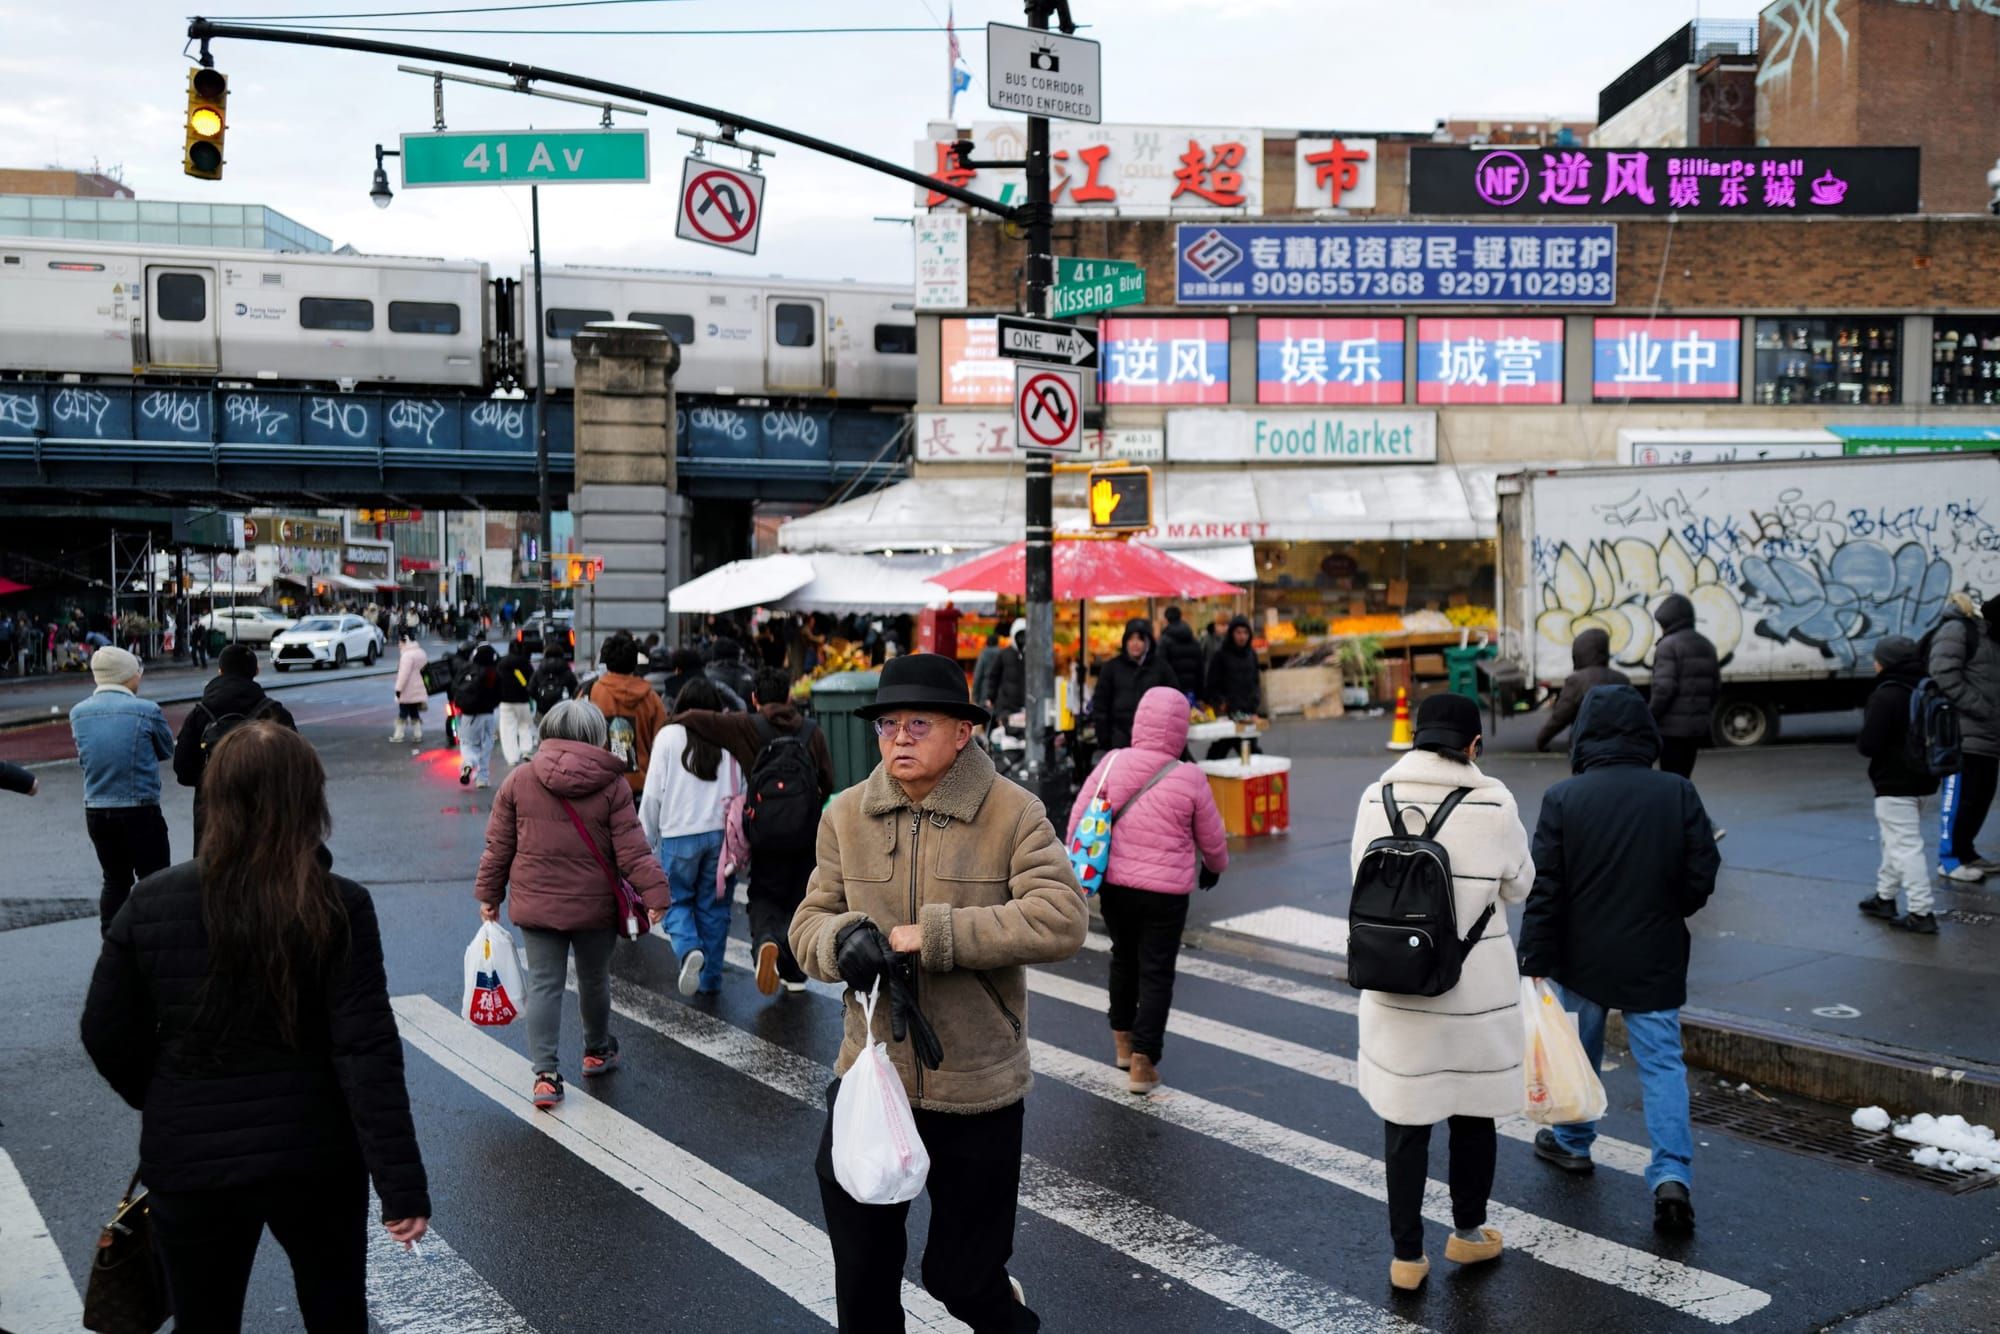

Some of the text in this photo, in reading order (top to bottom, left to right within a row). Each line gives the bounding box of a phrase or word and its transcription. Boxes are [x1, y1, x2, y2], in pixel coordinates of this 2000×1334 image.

[1005, 72, 1085, 96] BUS CORRIDOR
[998, 90, 1092, 116] PHOTO ENFORCED
[463, 142, 507, 173] 41
[1761, 159, 1803, 177] Hall
[1484, 166, 1520, 196] NF
[1538, 151, 1656, 206] 逆风
[1669, 176, 1797, 208] 娱乐城
[1073, 263, 1095, 282] 41
[1252, 271, 1425, 296] 9096557368
[1438, 271, 1612, 296] 9297102993
[1054, 273, 1142, 314] Kissena Blvd
[1013, 332, 1042, 350] ONE
[1056, 337, 1085, 355] WAY
[1111, 329, 1717, 387] 逆风 娱乐 城营 业中
[1255, 418, 1413, 455] Food Market
[1167, 522, 1271, 538] MARKET
